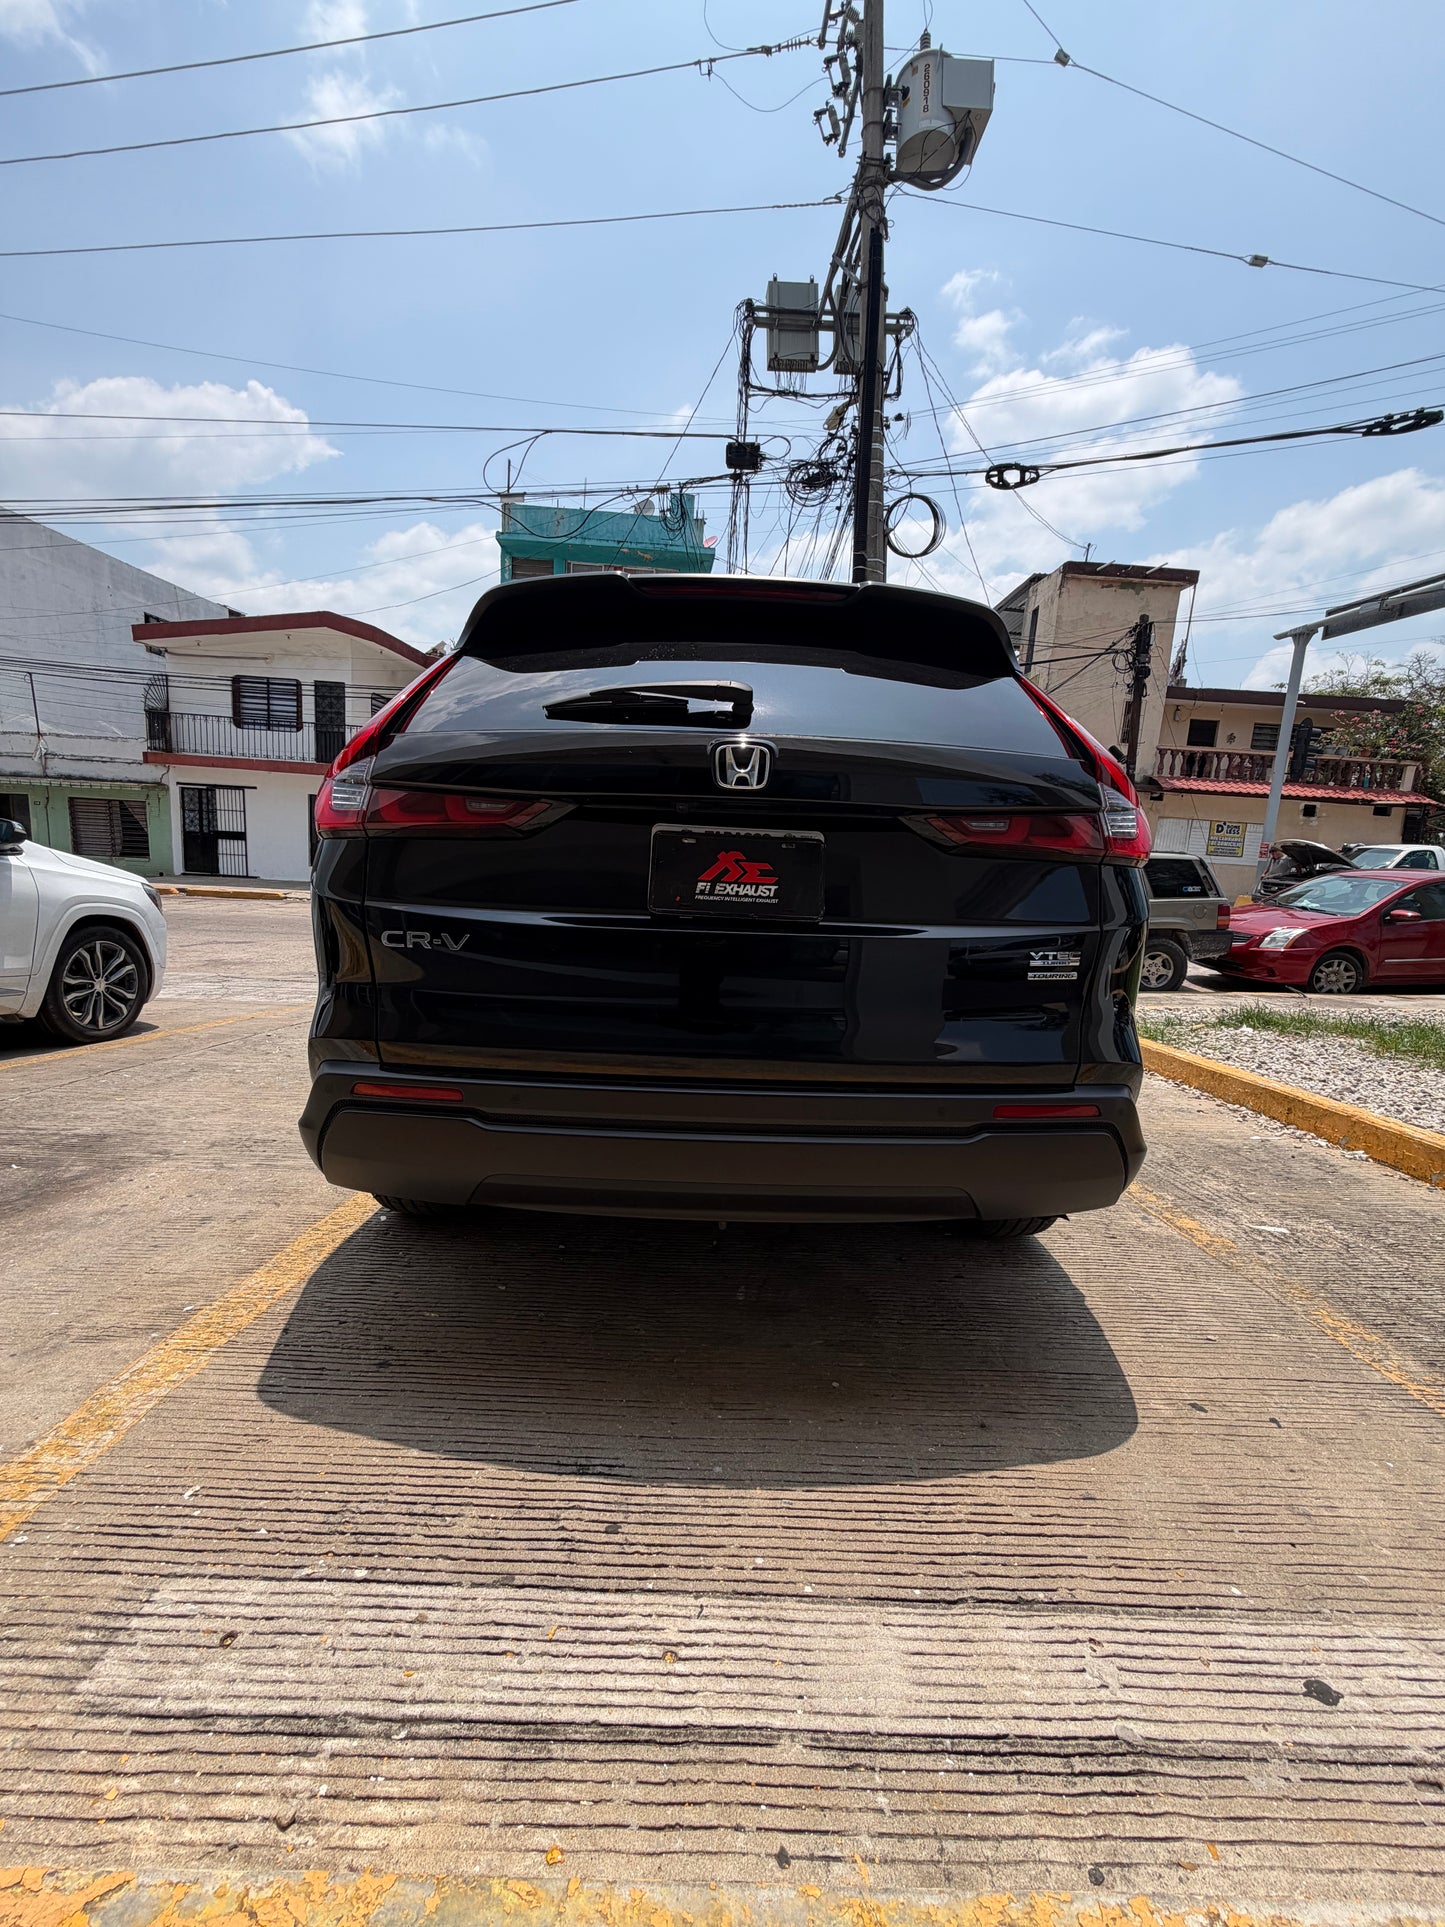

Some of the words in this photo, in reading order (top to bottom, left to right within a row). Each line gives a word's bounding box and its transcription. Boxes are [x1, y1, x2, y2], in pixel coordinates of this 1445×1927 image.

[714, 882, 779, 897] EXHAUST
[381, 930, 470, 951] CR-V
[1030, 951, 1081, 960] VTEC
